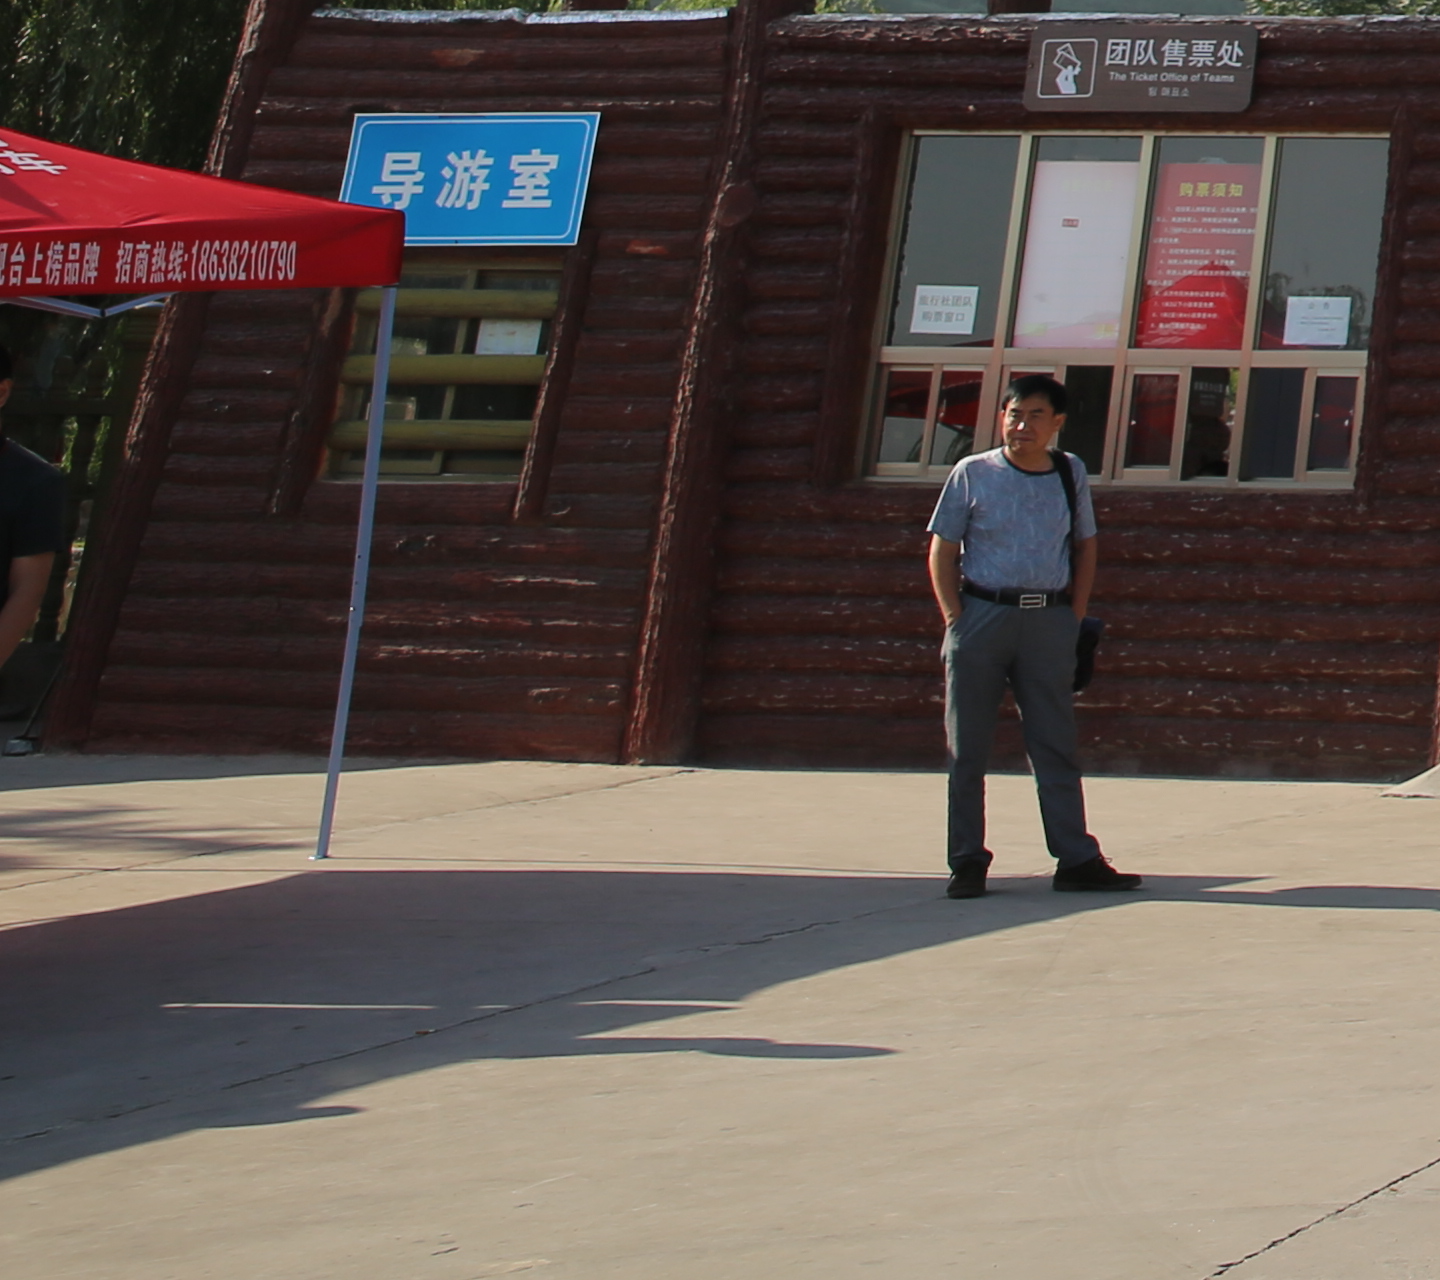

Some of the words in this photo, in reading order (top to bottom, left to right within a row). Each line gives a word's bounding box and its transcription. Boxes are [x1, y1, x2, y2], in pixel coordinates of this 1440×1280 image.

[1104, 38, 1245, 68] 团队售票处
[1109, 72, 1127, 82] The
[1130, 72, 1158, 82] Ticket
[1160, 72, 1188, 83] Office
[1190, 72, 1201, 83] of
[1202, 73, 1235, 83] Teams
[371, 148, 559, 210] 导游室
[1179, 182, 1243, 198] 购票须知
